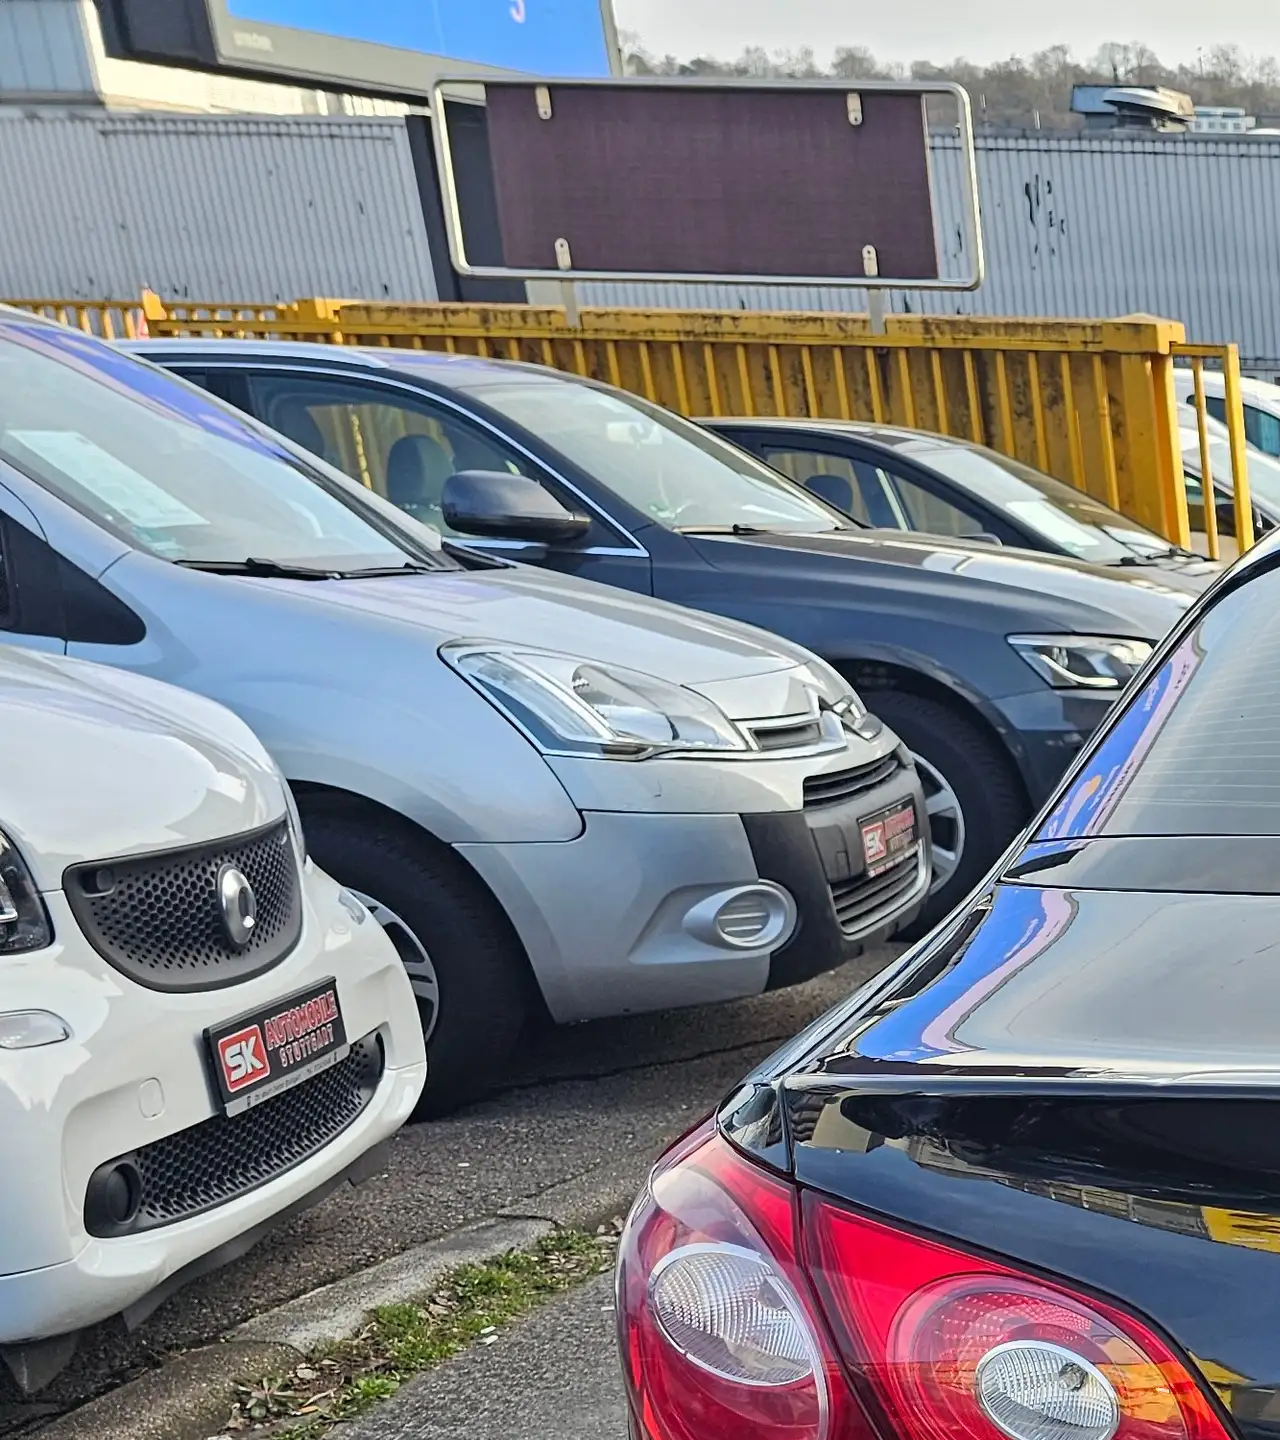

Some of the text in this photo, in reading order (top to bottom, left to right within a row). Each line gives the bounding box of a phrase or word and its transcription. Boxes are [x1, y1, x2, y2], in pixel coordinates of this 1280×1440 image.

[264, 990, 339, 1051] AUTOMOBILE
[225, 1036, 263, 1081] SK
[280, 1023, 334, 1068] STUTTGART
